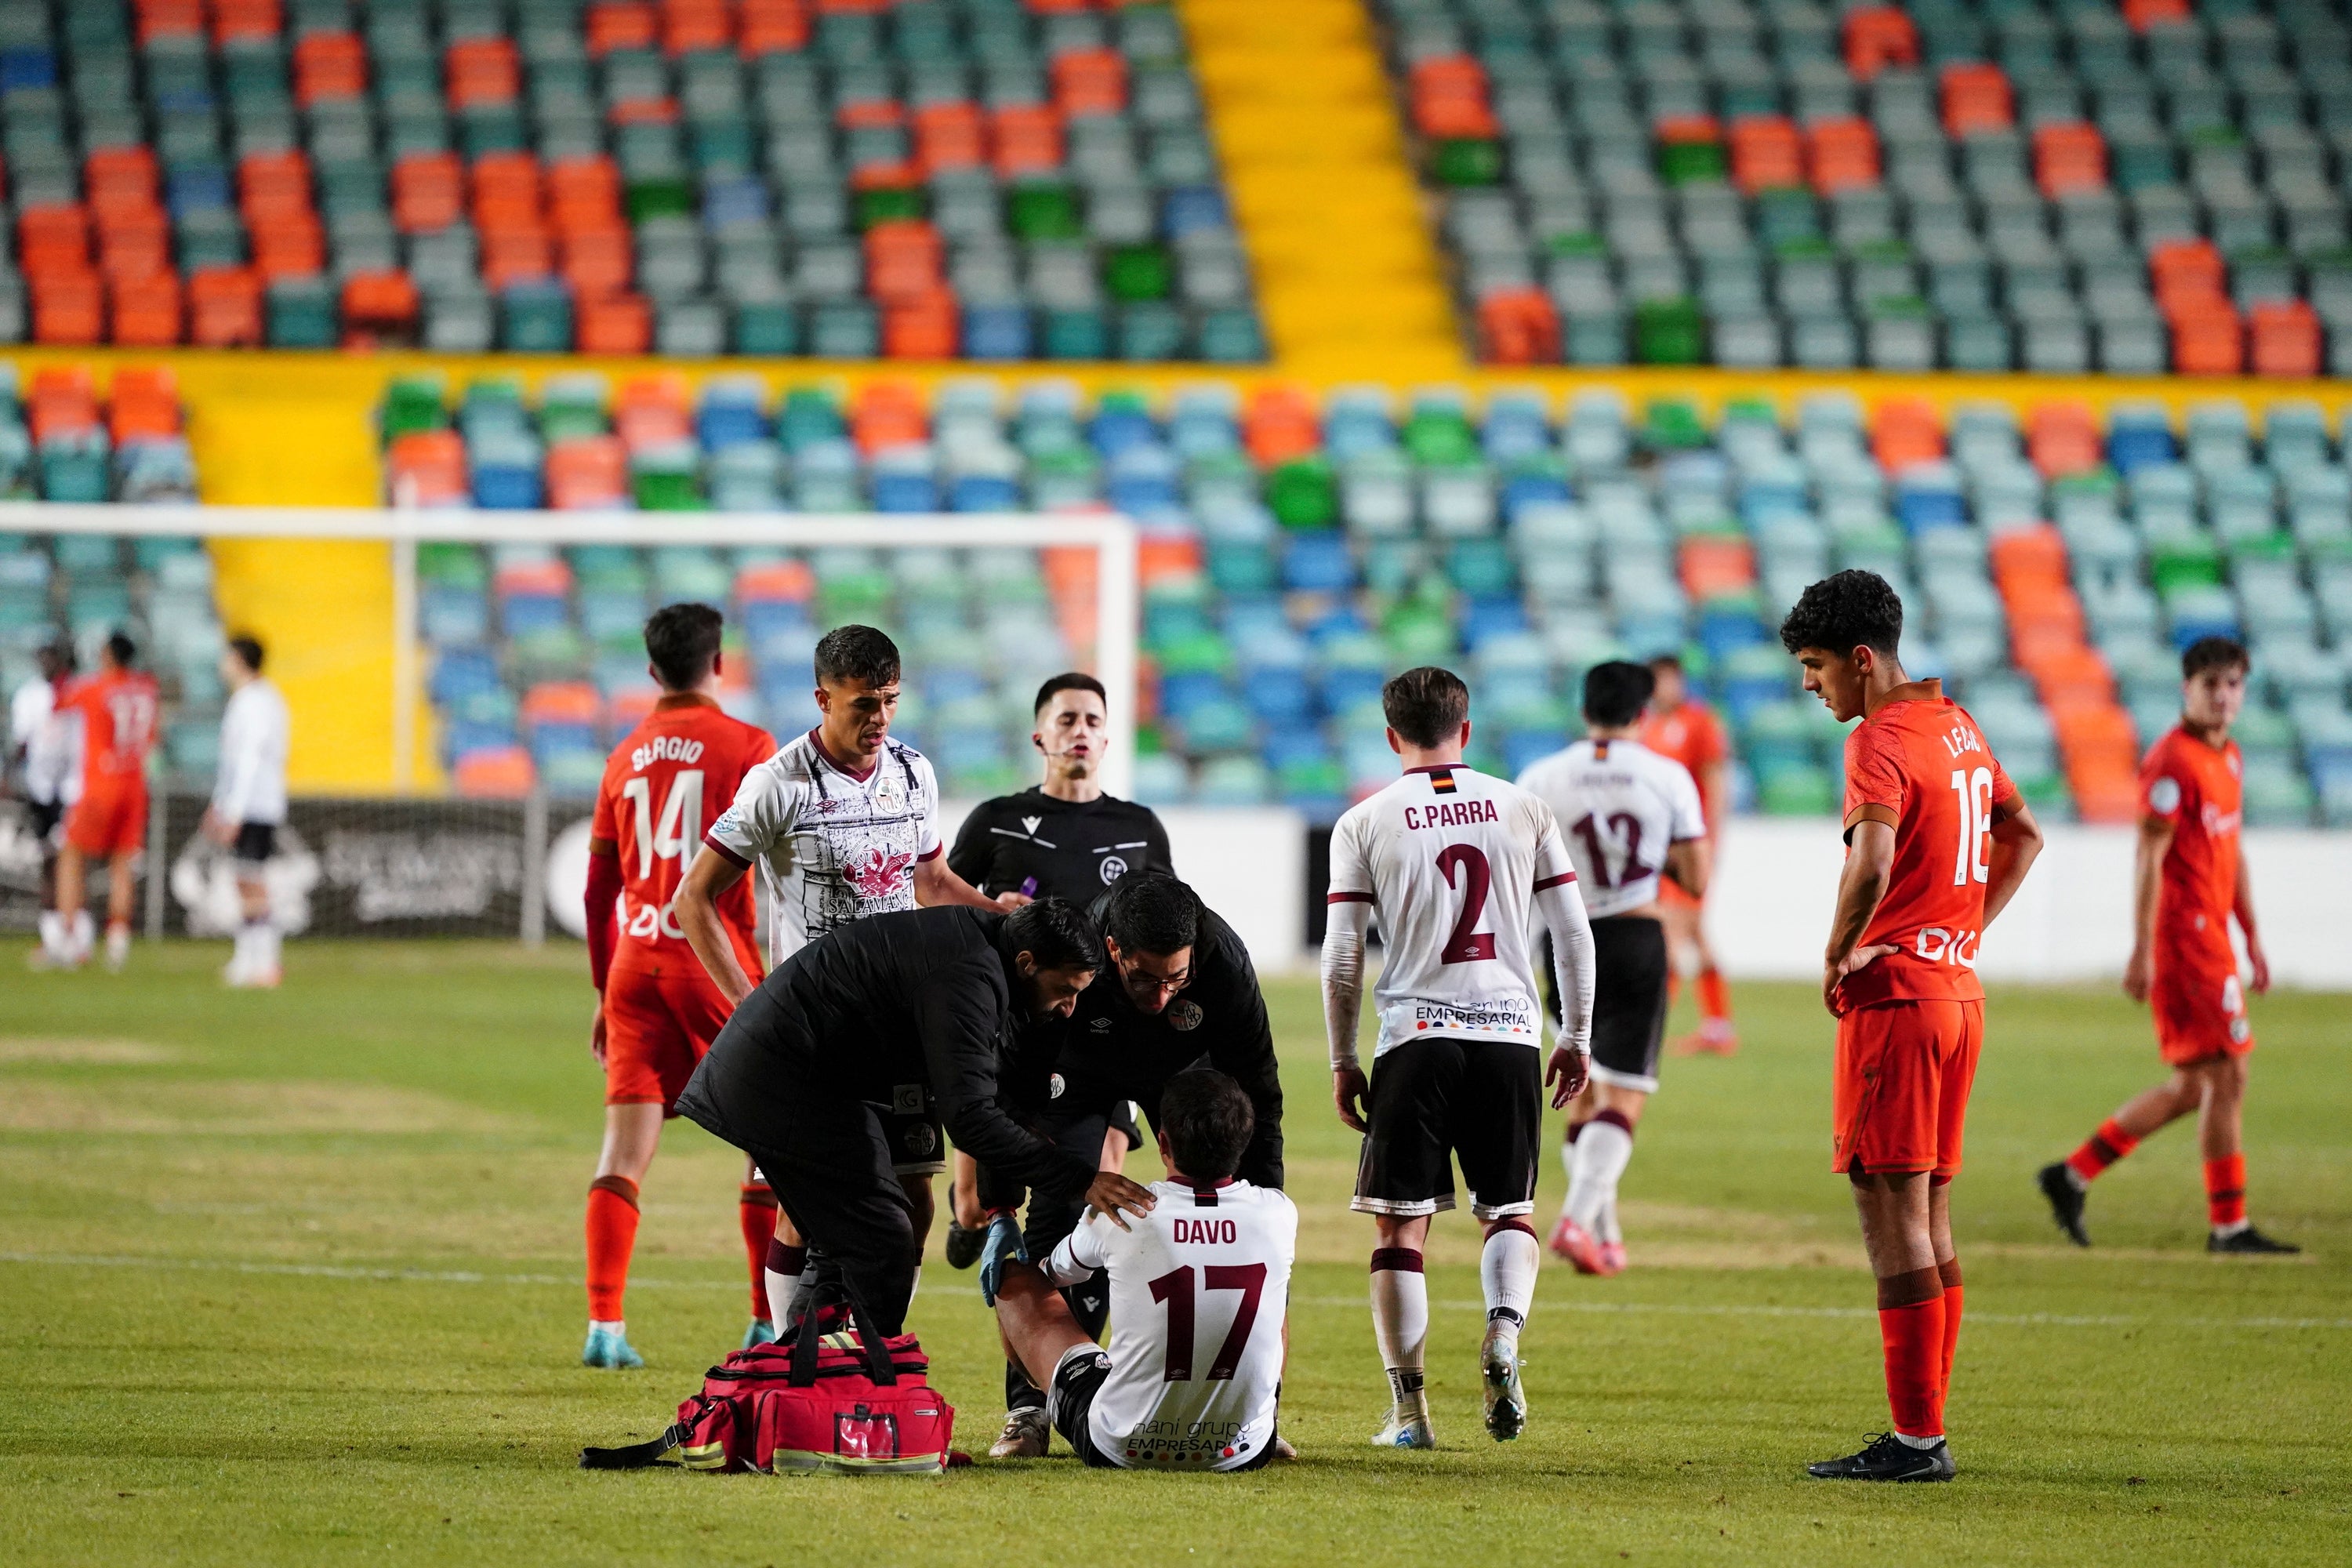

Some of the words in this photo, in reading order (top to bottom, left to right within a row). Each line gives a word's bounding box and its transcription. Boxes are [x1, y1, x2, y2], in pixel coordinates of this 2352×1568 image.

[622, 769, 705, 880] 14
[1405, 800, 1498, 830] C.PARRA
[1571, 812, 1653, 889] 12
[1436, 844, 1497, 964] 2
[1417, 1007, 1532, 1027] EMPRESARIAL
[1174, 1219, 1236, 1244] DAVO
[1148, 1262, 1267, 1381] 17
[1131, 1418, 1180, 1436] nani
